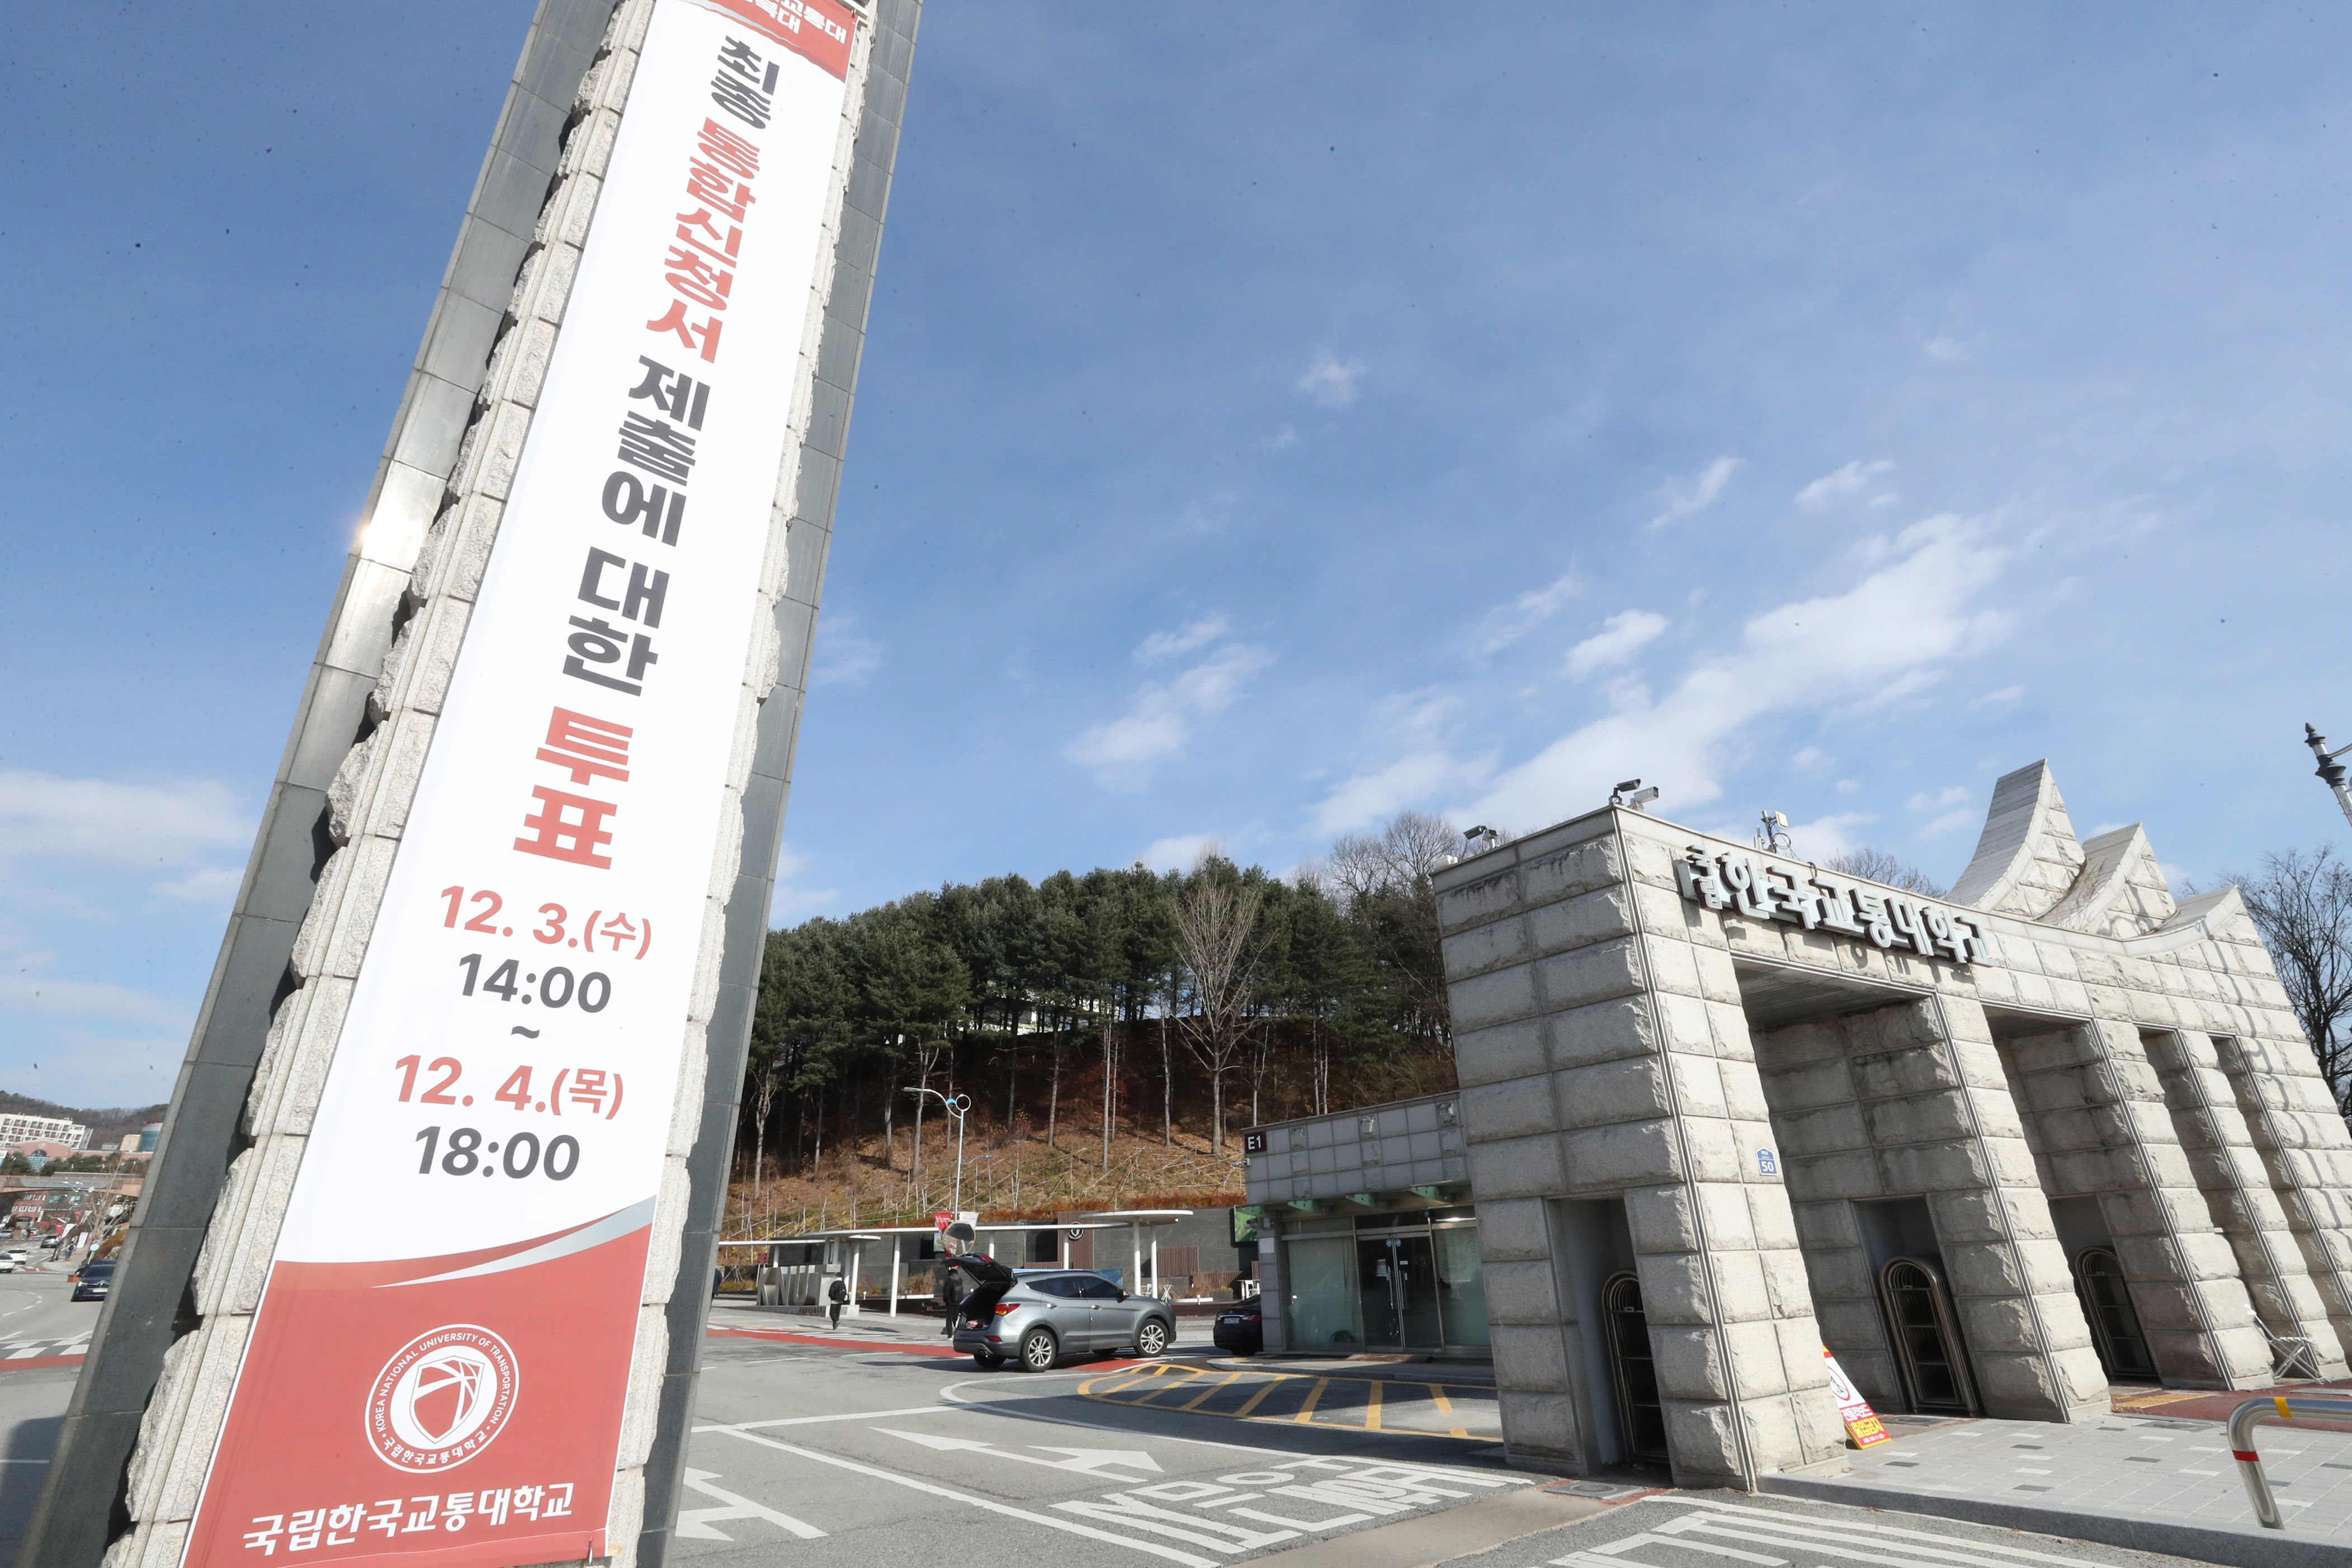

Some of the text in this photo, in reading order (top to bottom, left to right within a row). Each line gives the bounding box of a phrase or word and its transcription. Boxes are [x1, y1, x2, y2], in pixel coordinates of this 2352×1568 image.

[774, 0, 847, 44] 교통대
[513, 35, 780, 870] 최종 통합신청서 제출에 대한 투표
[441, 885, 651, 960] 12. 3.(수)
[1686, 844, 1996, 967] 국립 한국교통대학교
[459, 953, 611, 1013] 14:00
[395, 1054, 624, 1120] 12. 4.(목)
[415, 1126, 580, 1181] 18:00
[1248, 1135, 1261, 1150] E1
[1761, 1161, 1774, 1172] 50
[757, 1264, 829, 1306] KNUT
[375, 1333, 511, 1433] KOREA NATIONAL UNIVERSITY OF TRANSPORTATION
[383, 1430, 487, 1466] 국립한국교통대학교
[1850, 1416, 1885, 1438] 출입금지
[243, 1482, 574, 1556] 국립한국교통대학교
